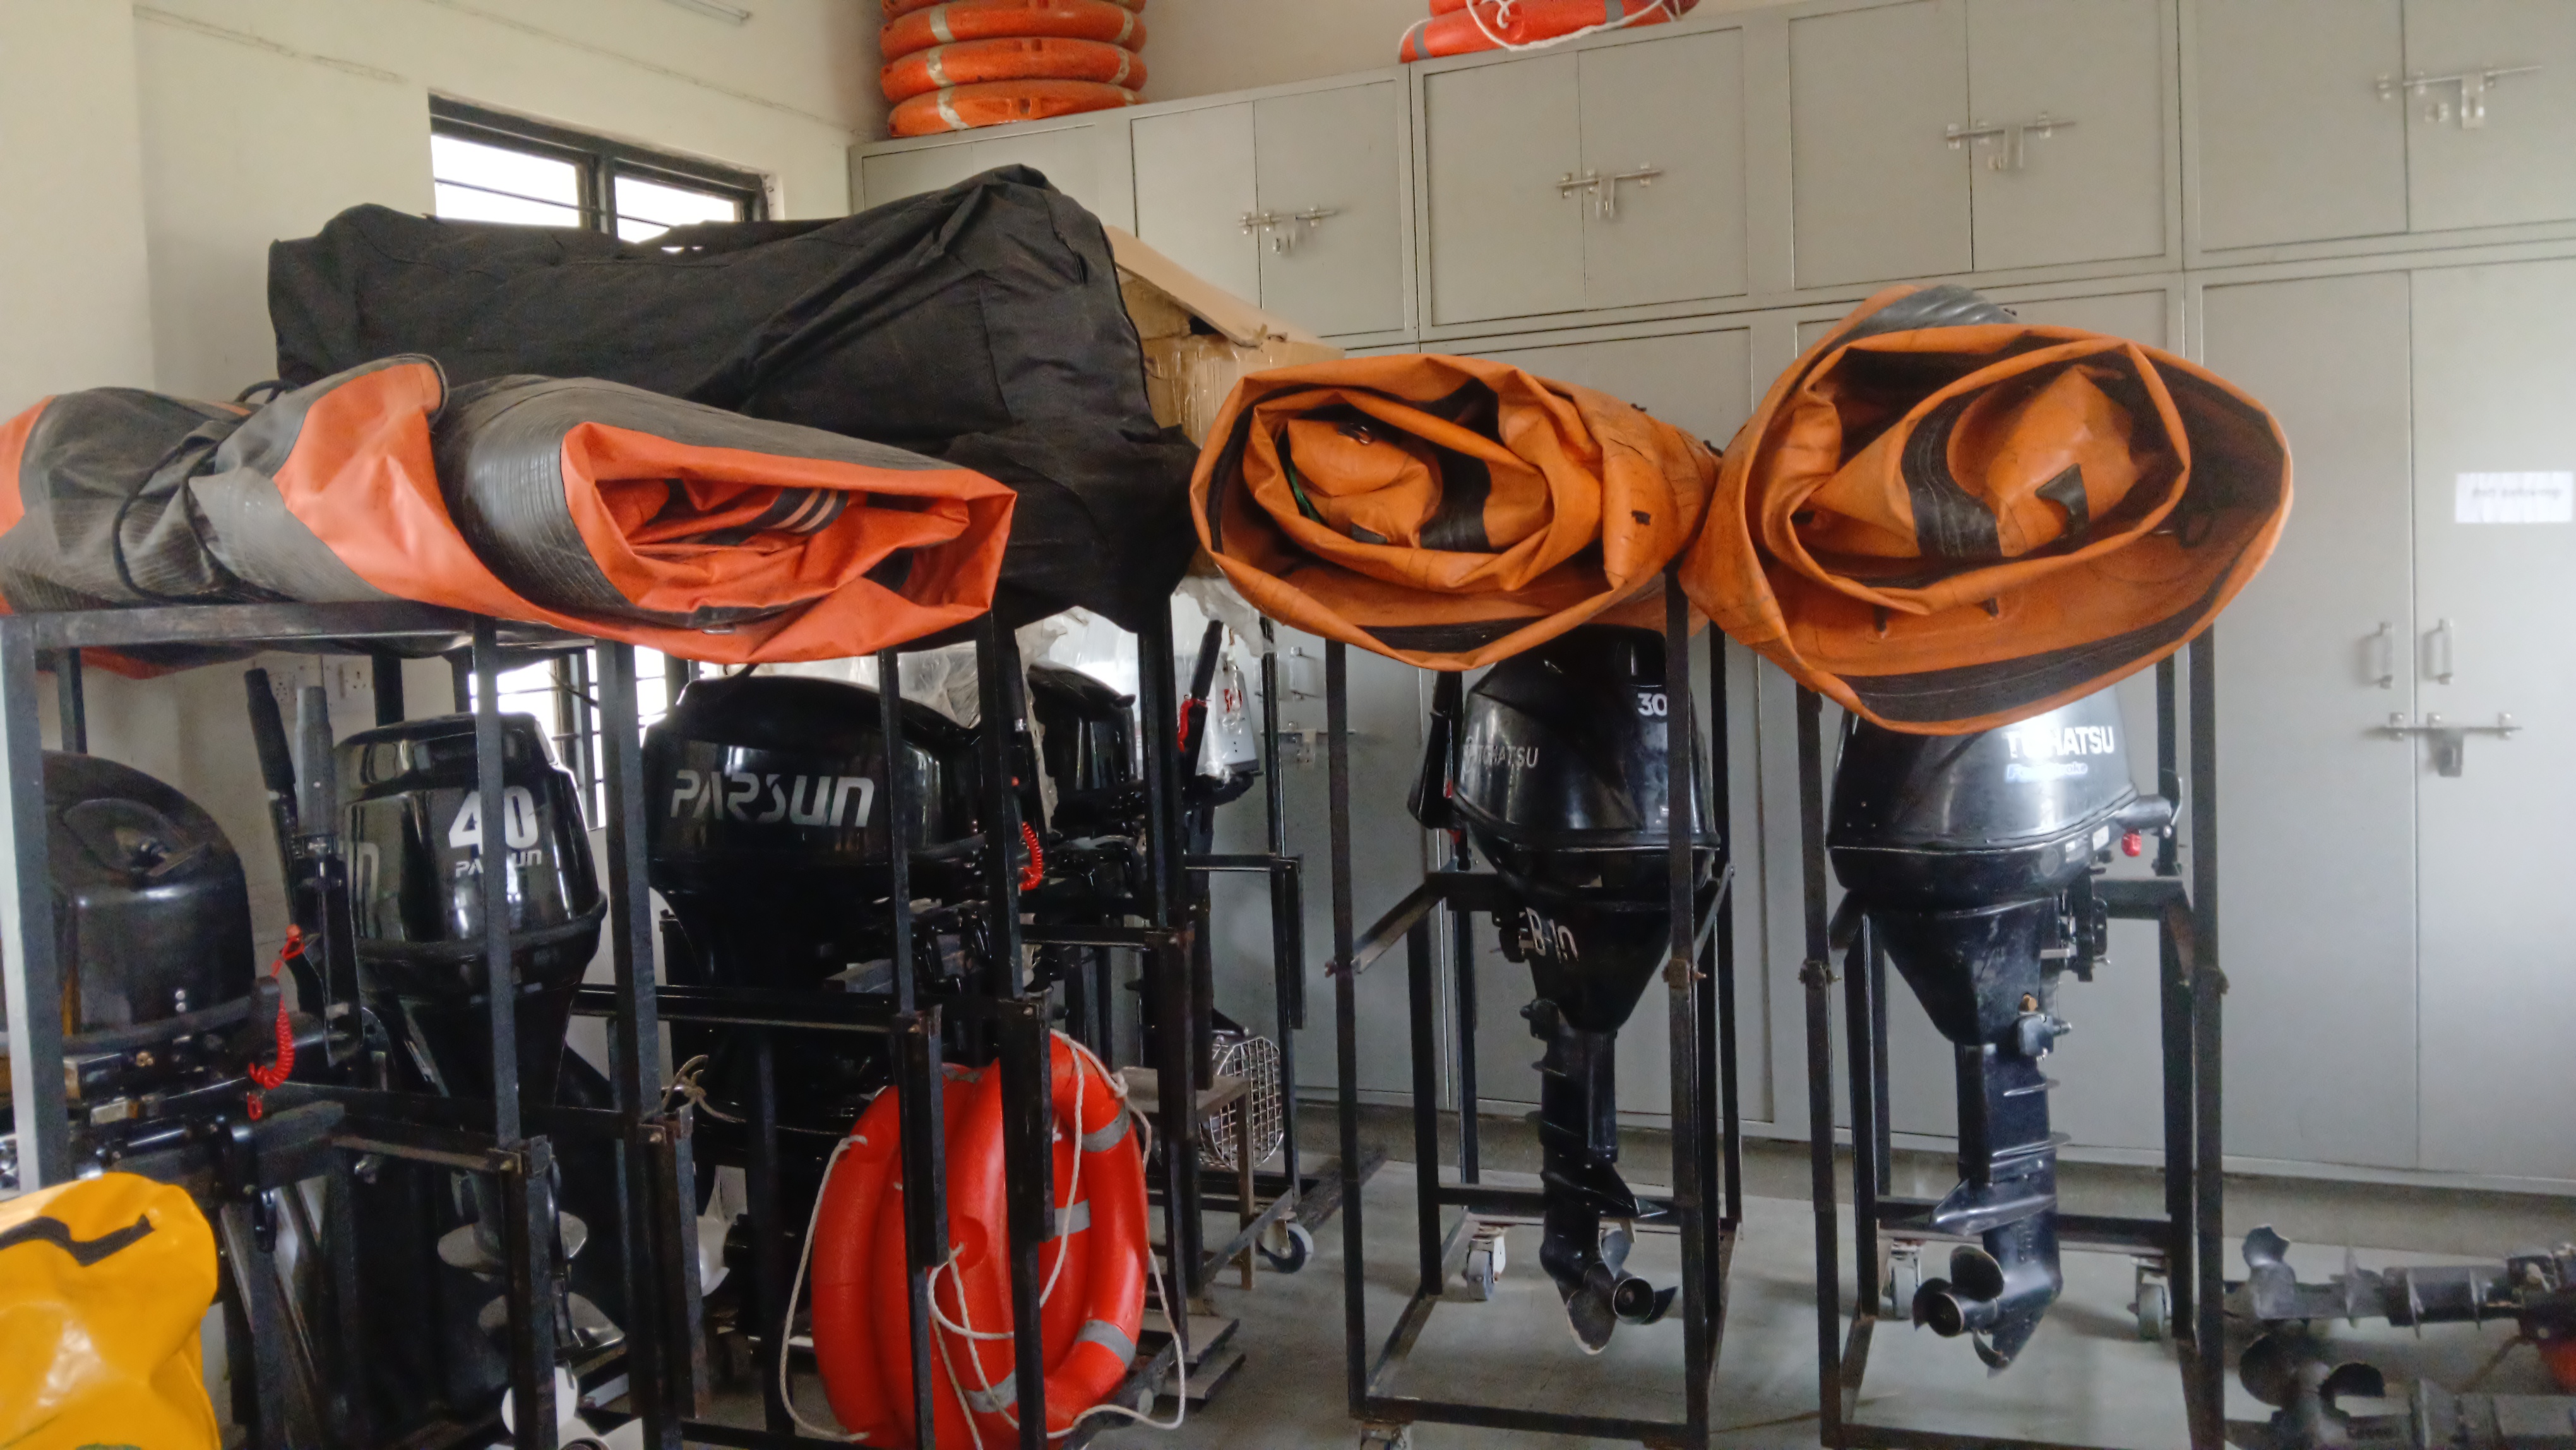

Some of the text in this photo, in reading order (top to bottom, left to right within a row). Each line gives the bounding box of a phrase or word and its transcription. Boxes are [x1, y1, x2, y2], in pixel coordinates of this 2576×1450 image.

[1638, 693, 1667, 716] 30
[2004, 726, 2114, 759] THATSU
[671, 769, 874, 827] PARSUN
[449, 786, 539, 854] 40
[455, 849, 542, 878] PAUN
